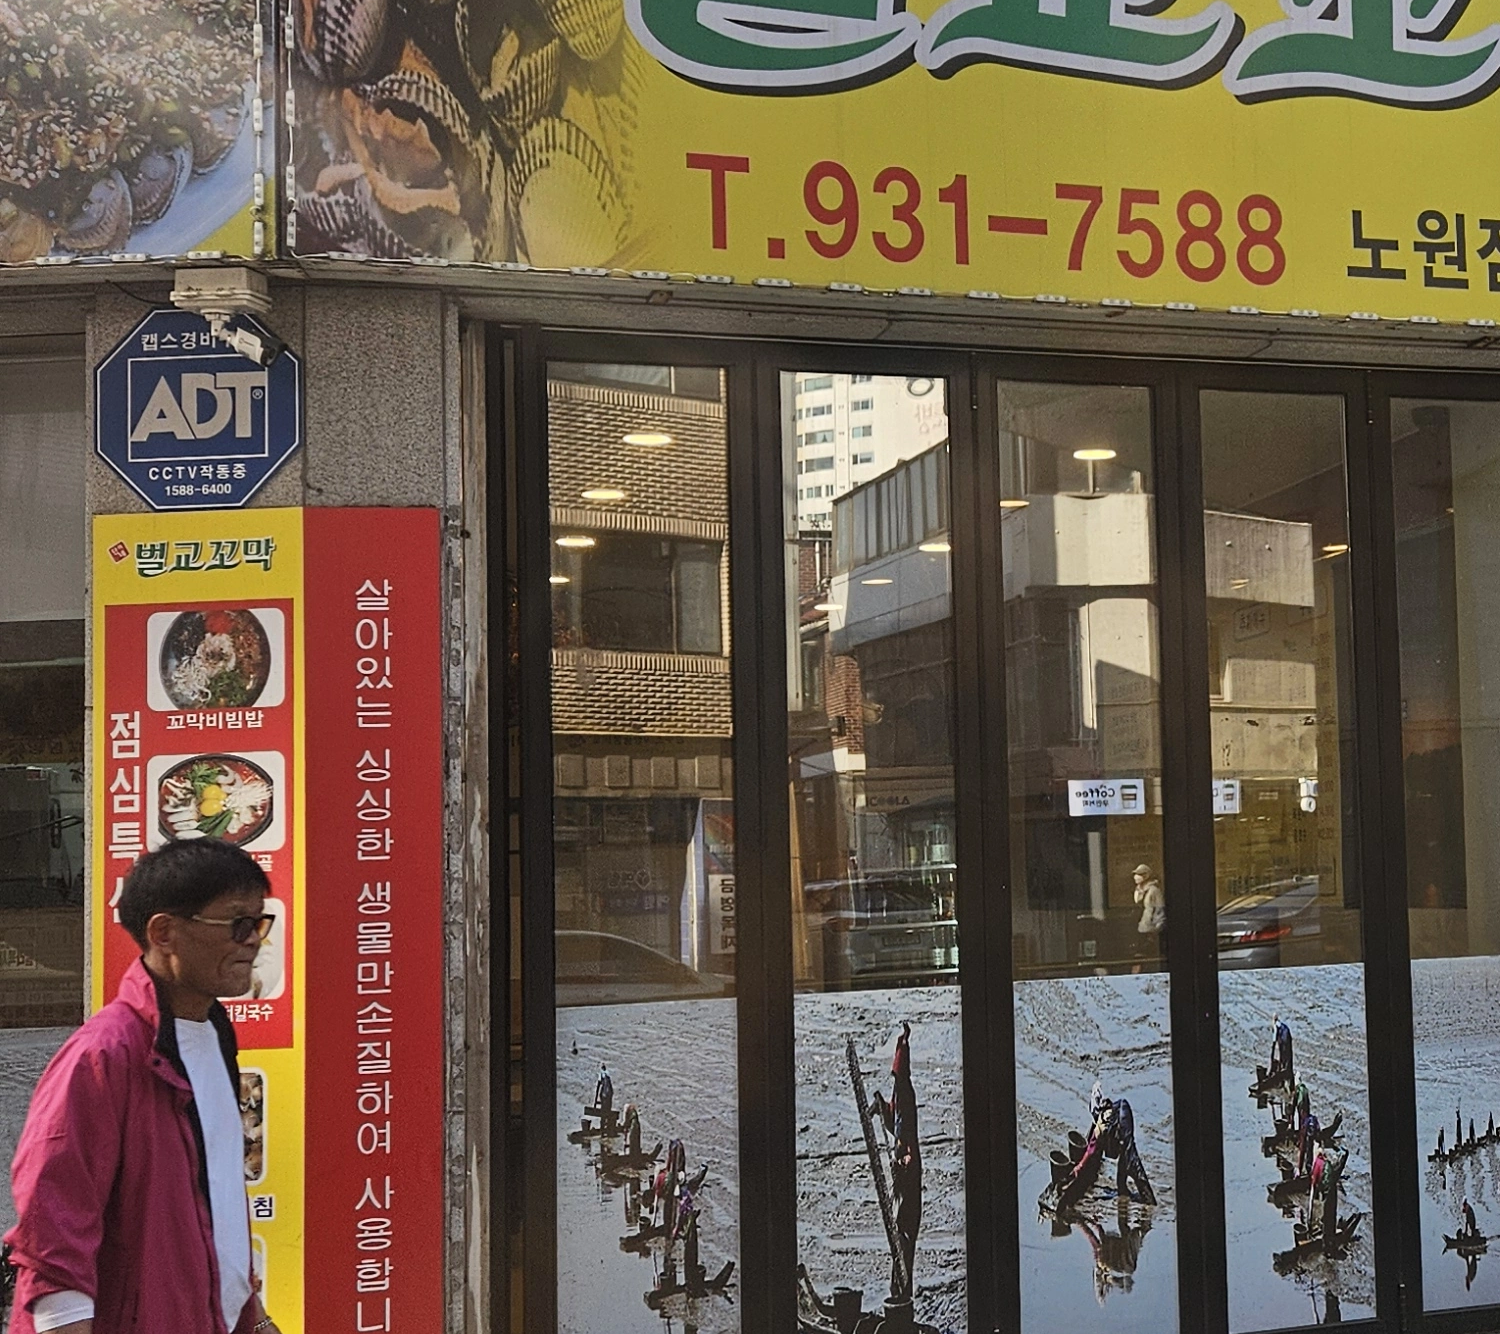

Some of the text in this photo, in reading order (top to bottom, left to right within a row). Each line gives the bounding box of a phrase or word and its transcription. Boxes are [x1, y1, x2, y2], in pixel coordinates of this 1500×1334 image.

[130, 370, 267, 443] ADT
[148, 463, 247, 481] CCTV작동중
[164, 483, 232, 497] 1588-6400
[134, 536, 277, 578] 벌교꼬막
[354, 579, 394, 730] 살아있는
[166, 710, 264, 731] 꼬막비빔밥
[355, 750, 394, 862] 싱싱한
